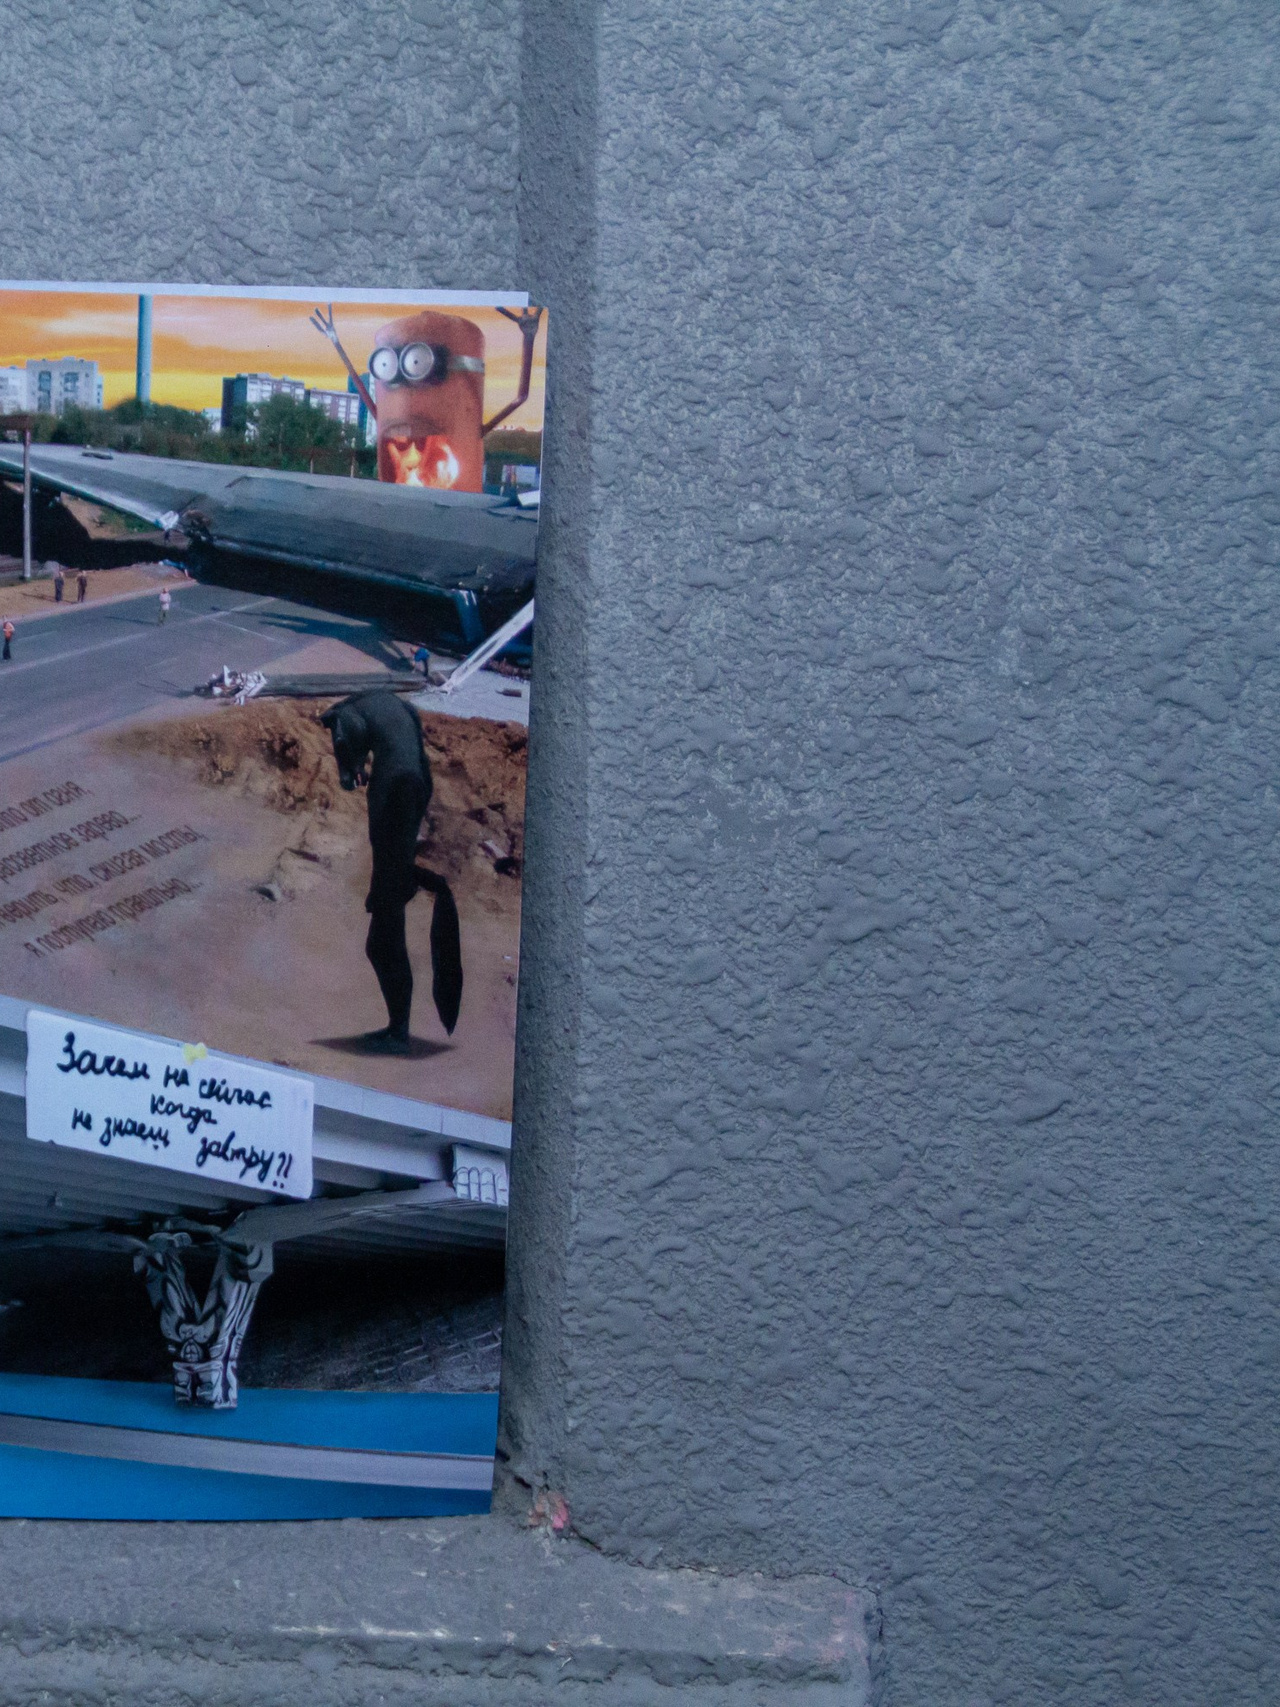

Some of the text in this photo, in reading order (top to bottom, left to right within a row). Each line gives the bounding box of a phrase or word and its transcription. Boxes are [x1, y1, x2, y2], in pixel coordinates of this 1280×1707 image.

[20, 796, 53, 817] от
[88, 848, 152, 882] сжигая
[23, 941, 46, 959] я
[36, 909, 117, 953] поступаю
[56, 1031, 150, 1081] Зачем
